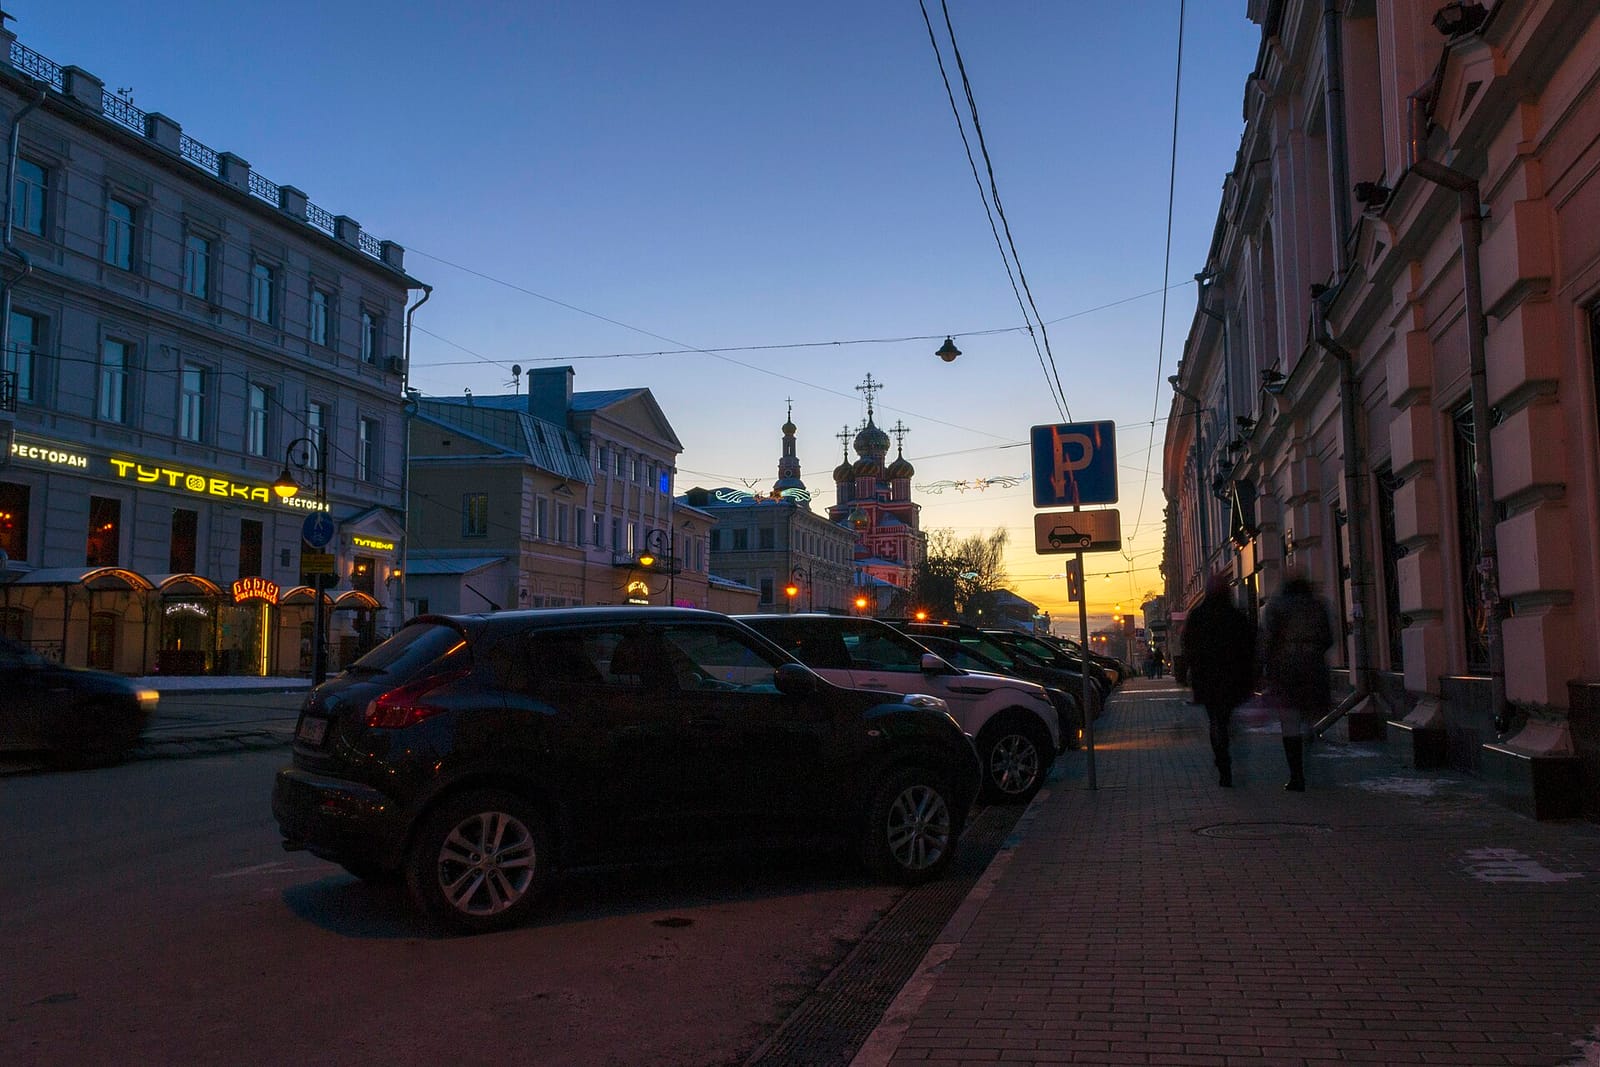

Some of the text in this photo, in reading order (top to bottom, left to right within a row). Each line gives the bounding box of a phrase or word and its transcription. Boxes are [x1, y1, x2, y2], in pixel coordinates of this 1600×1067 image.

[110, 458, 269, 502] ТУТОВКА
[1053, 434, 1093, 498] P
[353, 537, 394, 550] ТУТОВКА
